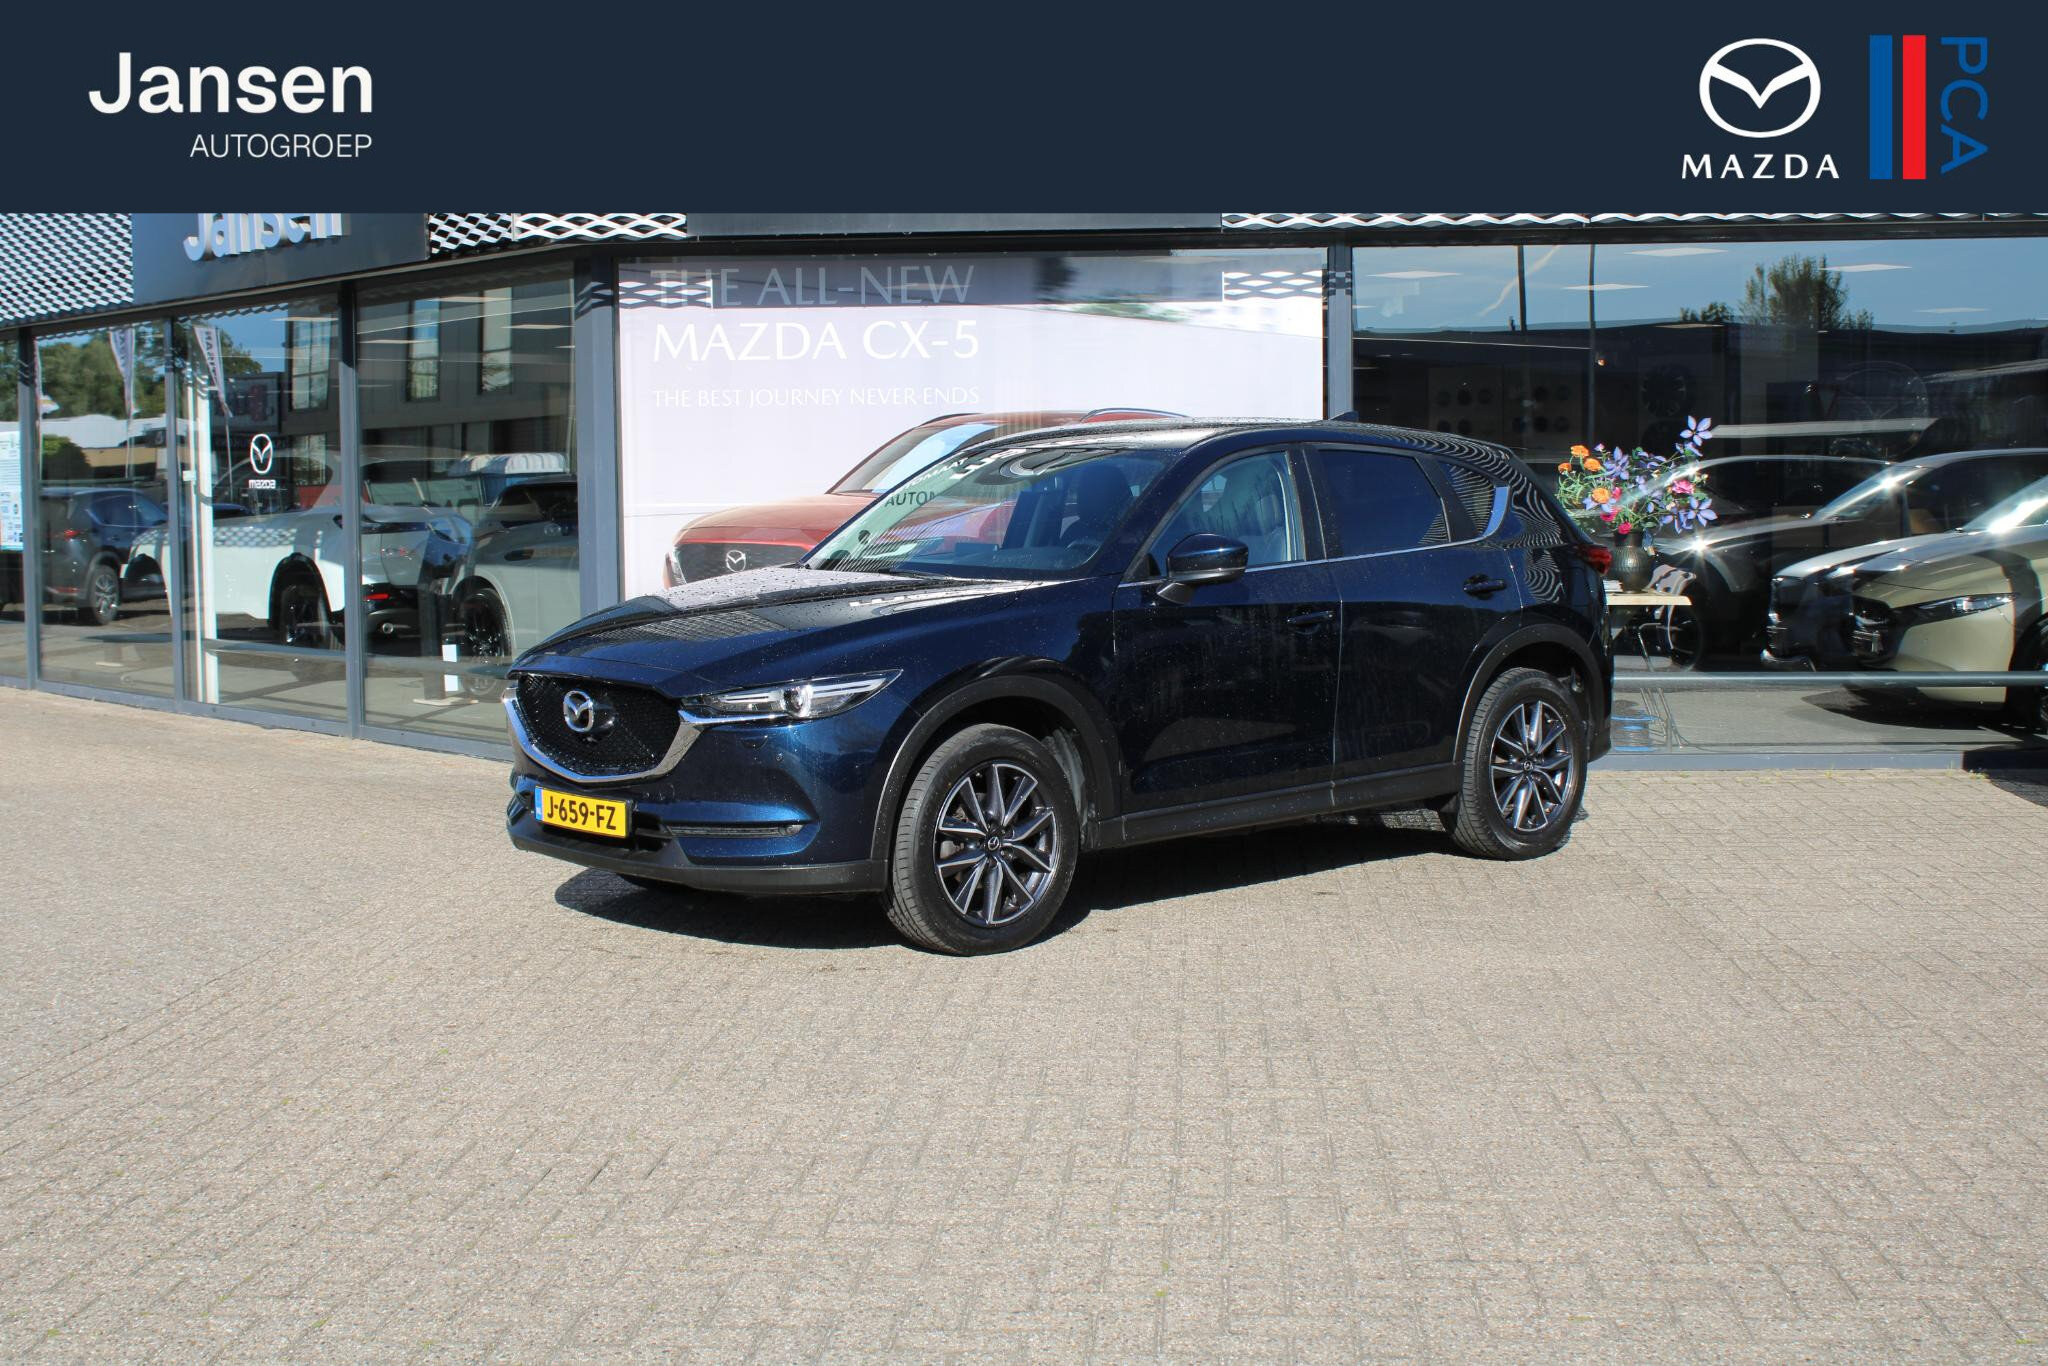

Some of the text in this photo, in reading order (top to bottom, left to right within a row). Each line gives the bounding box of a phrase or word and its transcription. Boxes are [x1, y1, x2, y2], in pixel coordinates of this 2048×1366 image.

[655, 265, 975, 306] THE ALL-NEW
[653, 320, 979, 361] MAZDA CX-5
[653, 386, 980, 408] THE BEST JOURNEY NEVER ENDS
[547, 796, 616, 830] J-659-FZ
